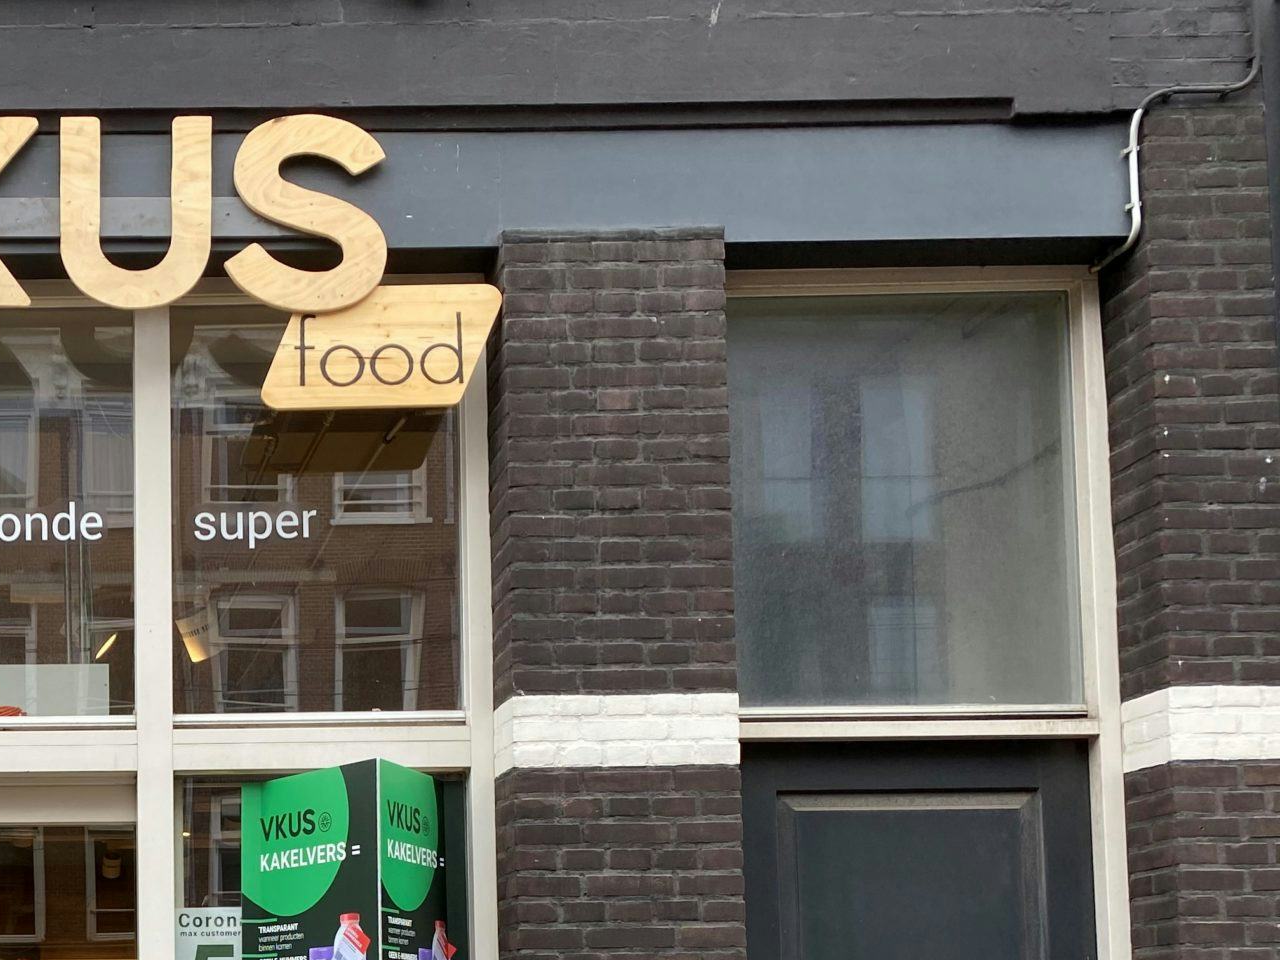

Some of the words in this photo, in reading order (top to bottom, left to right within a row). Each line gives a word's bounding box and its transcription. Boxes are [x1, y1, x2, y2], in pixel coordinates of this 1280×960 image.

[294, 312, 464, 387] food
[193, 505, 317, 551] super
[260, 808, 316, 842] VKUS
[387, 799, 420, 836] VKUS
[260, 841, 346, 872] KAKELVERS
[387, 837, 438, 869] KAKELVERS
[179, 913, 241, 928] Coron
